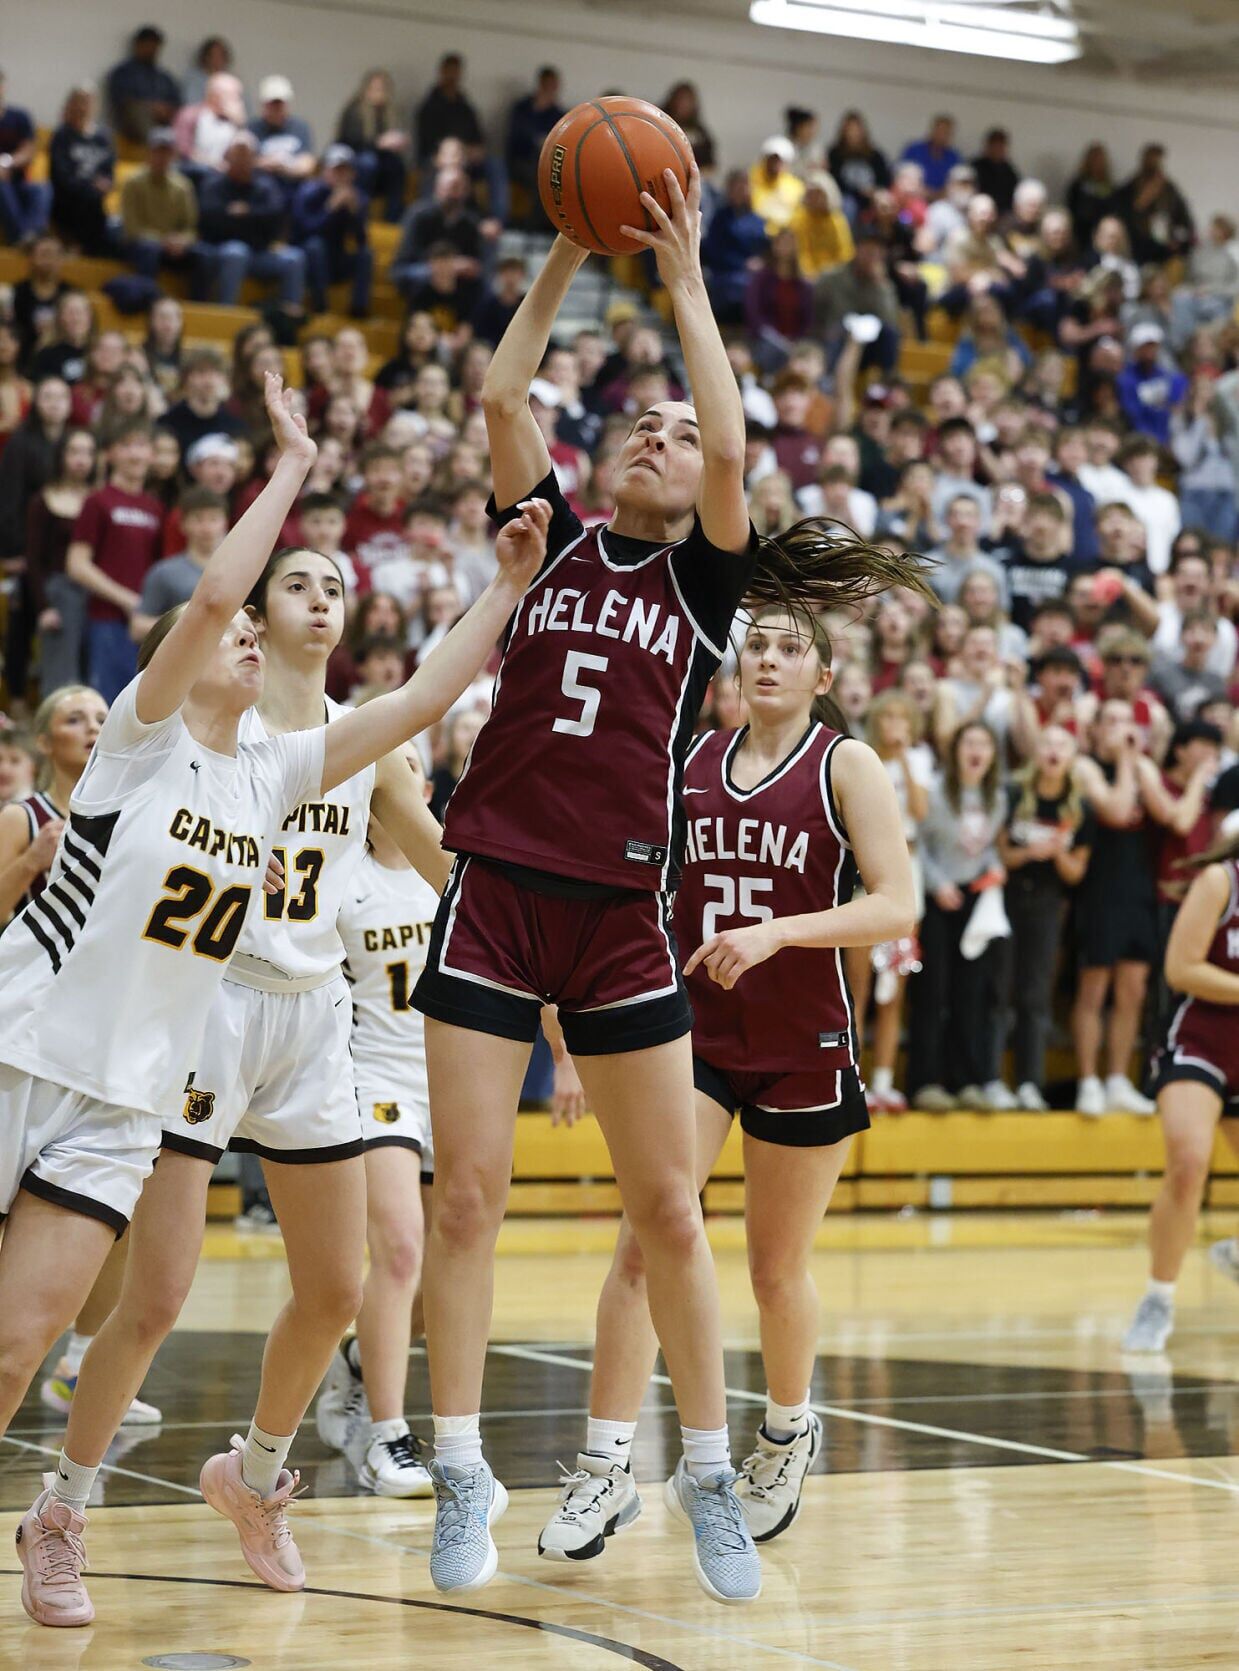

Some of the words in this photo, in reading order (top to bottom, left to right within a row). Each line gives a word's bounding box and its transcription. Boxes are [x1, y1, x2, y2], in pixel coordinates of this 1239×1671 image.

[551, 147, 564, 184] PRO
[528, 587, 680, 666] HELENA
[552, 649, 609, 737] 5
[168, 807, 261, 868] CAPITA
[280, 802, 350, 837] PITAL
[140, 863, 253, 964] 20
[702, 873, 774, 946] 25
[384, 960, 413, 1014] 1
